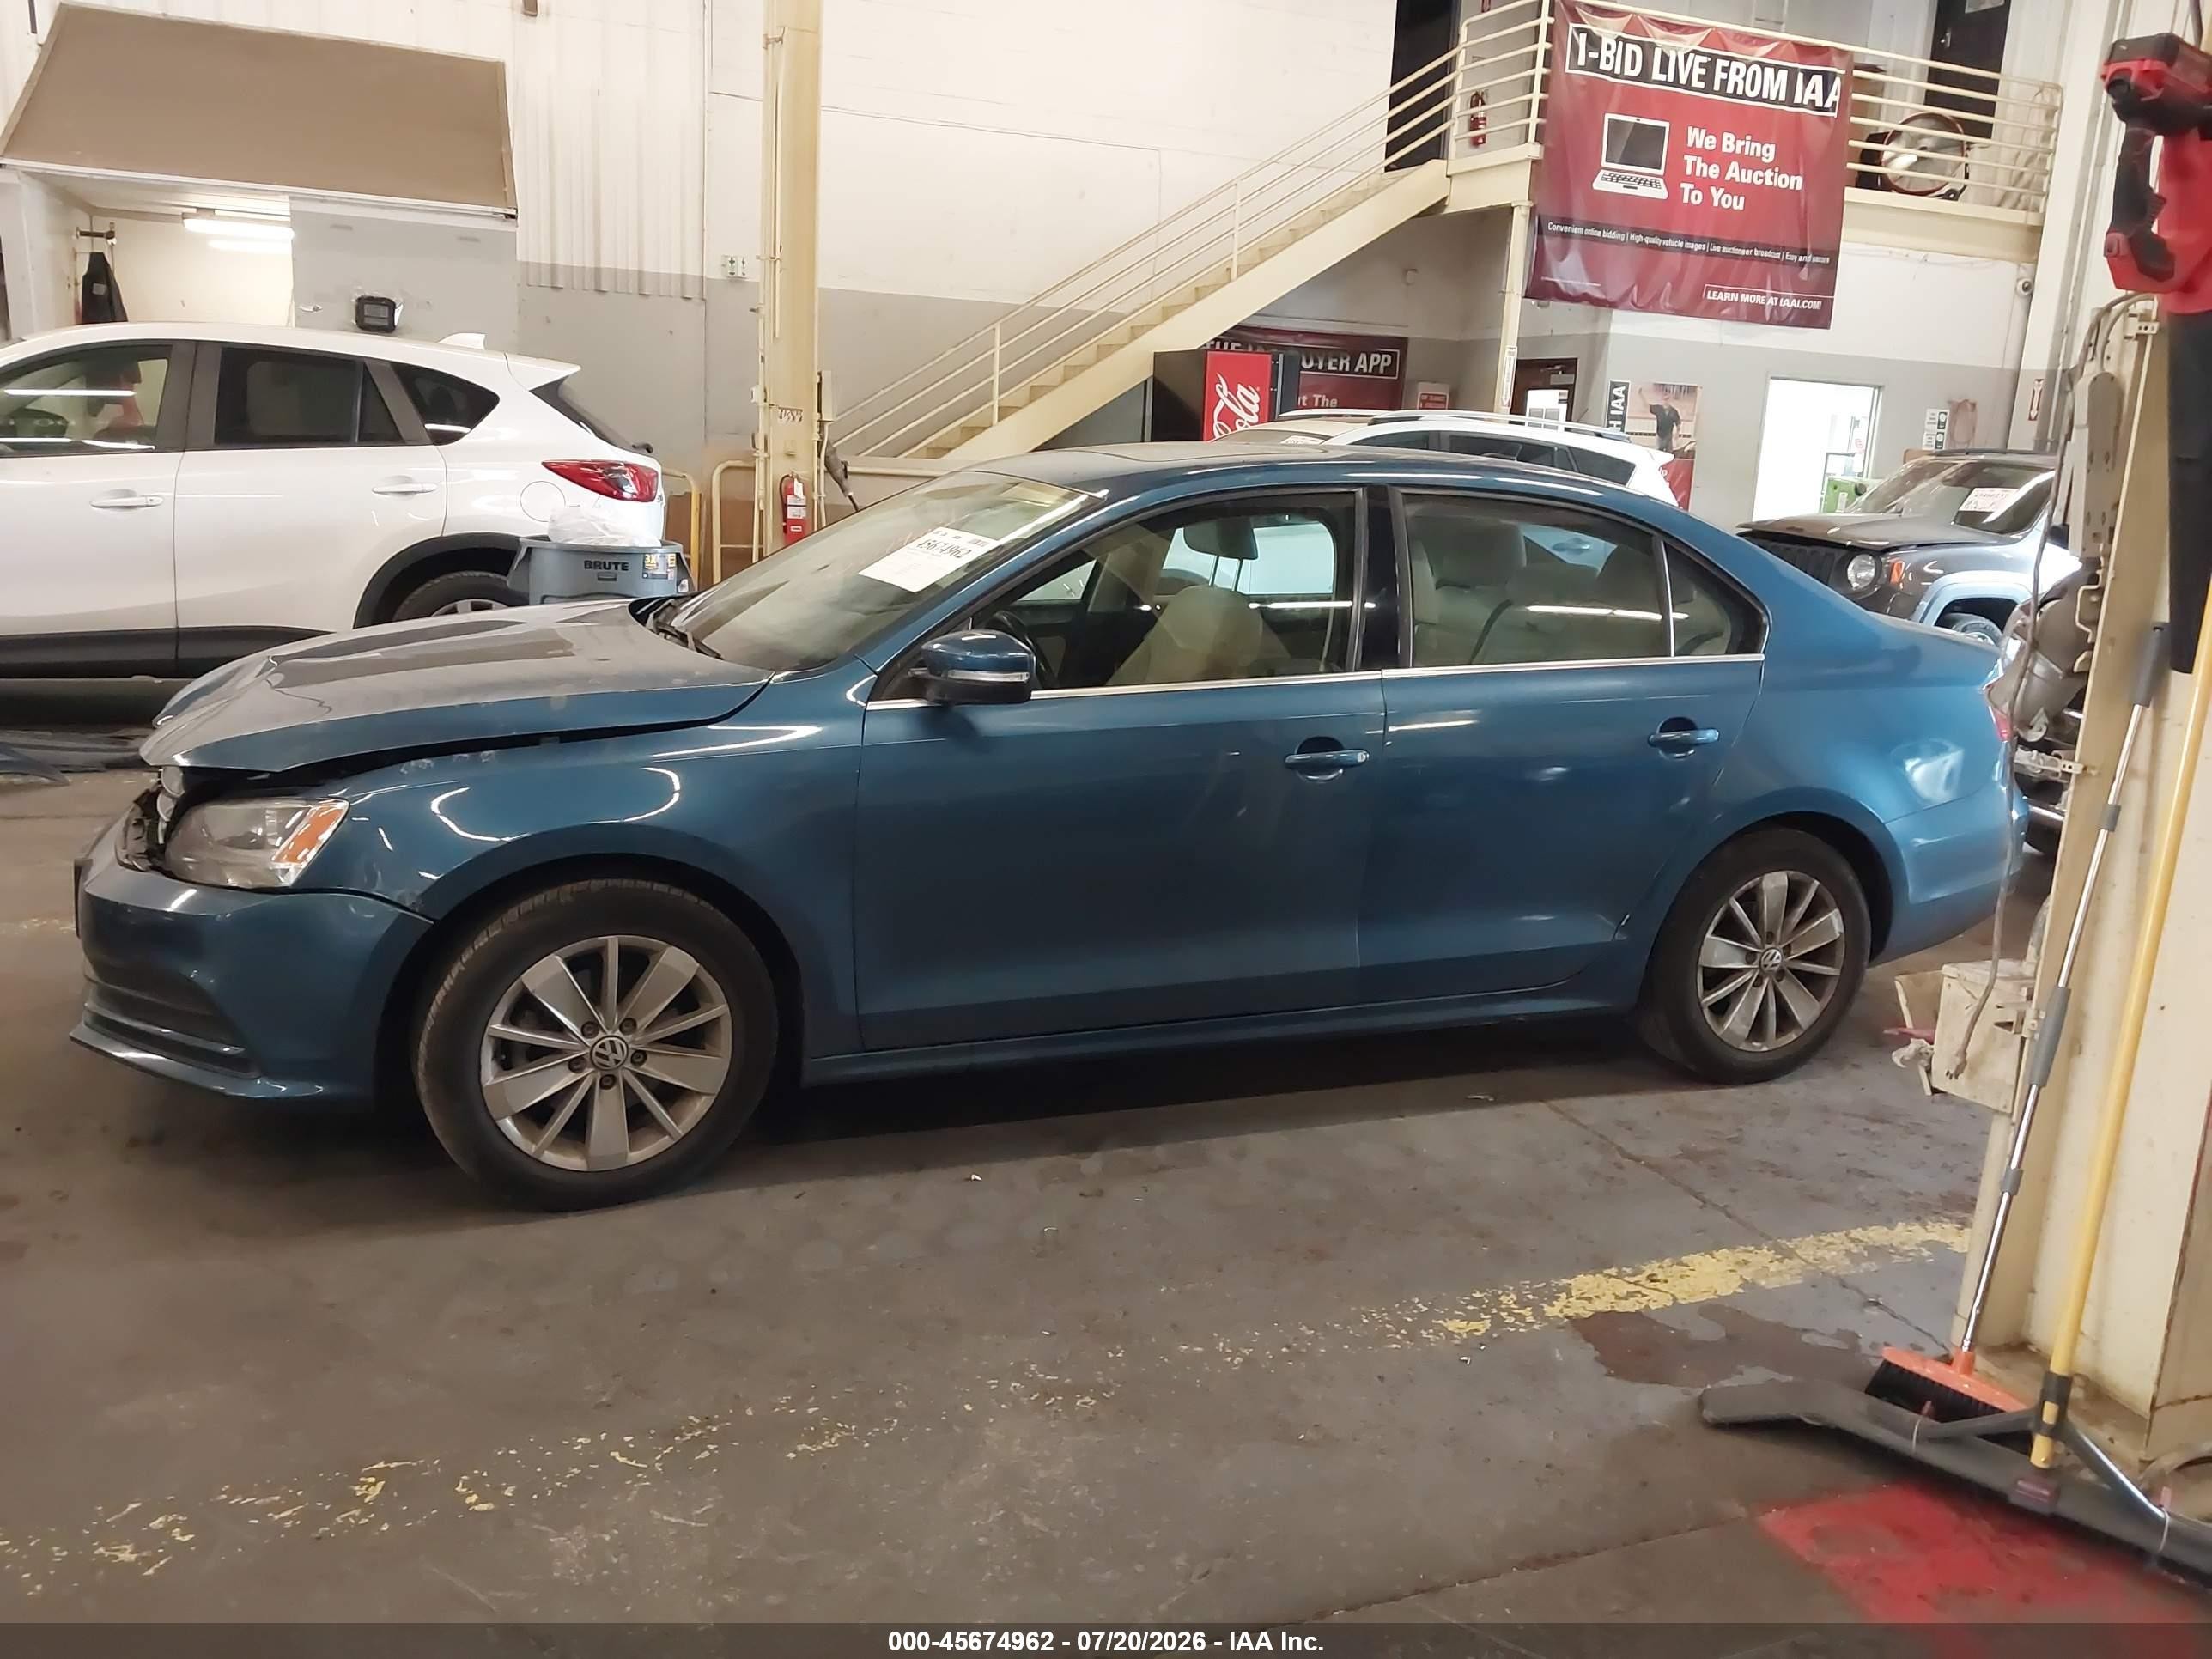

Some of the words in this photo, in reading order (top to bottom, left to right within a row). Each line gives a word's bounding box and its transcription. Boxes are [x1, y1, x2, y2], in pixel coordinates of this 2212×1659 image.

[1577, 33, 1644, 78] I-BID
[1651, 46, 1711, 88] LIVE
[1713, 58, 1789, 101] FROM
[1793, 71, 1842, 108] IAA
[1687, 125, 1717, 150] We
[1721, 131, 1776, 163] Bring
[1683, 154, 1720, 179] The
[1724, 161, 1803, 191] Auction
[1680, 182, 1703, 205] To
[1710, 185, 1745, 210] You
[1547, 222, 1584, 235] Convenient
[1602, 229, 1626, 241] bidding
[1662, 237, 1684, 249] vehicle
[1684, 240, 1706, 252] images
[1798, 252, 1812, 263] and
[1706, 289, 1739, 302] LEARN
[1741, 292, 1765, 305] MORE
[1766, 295, 1778, 307] AT
[1354, 352, 1392, 374] APP
[1312, 393, 1338, 408] The
[1611, 386, 1626, 416] IAA
[584, 559, 629, 571] BRUTE
